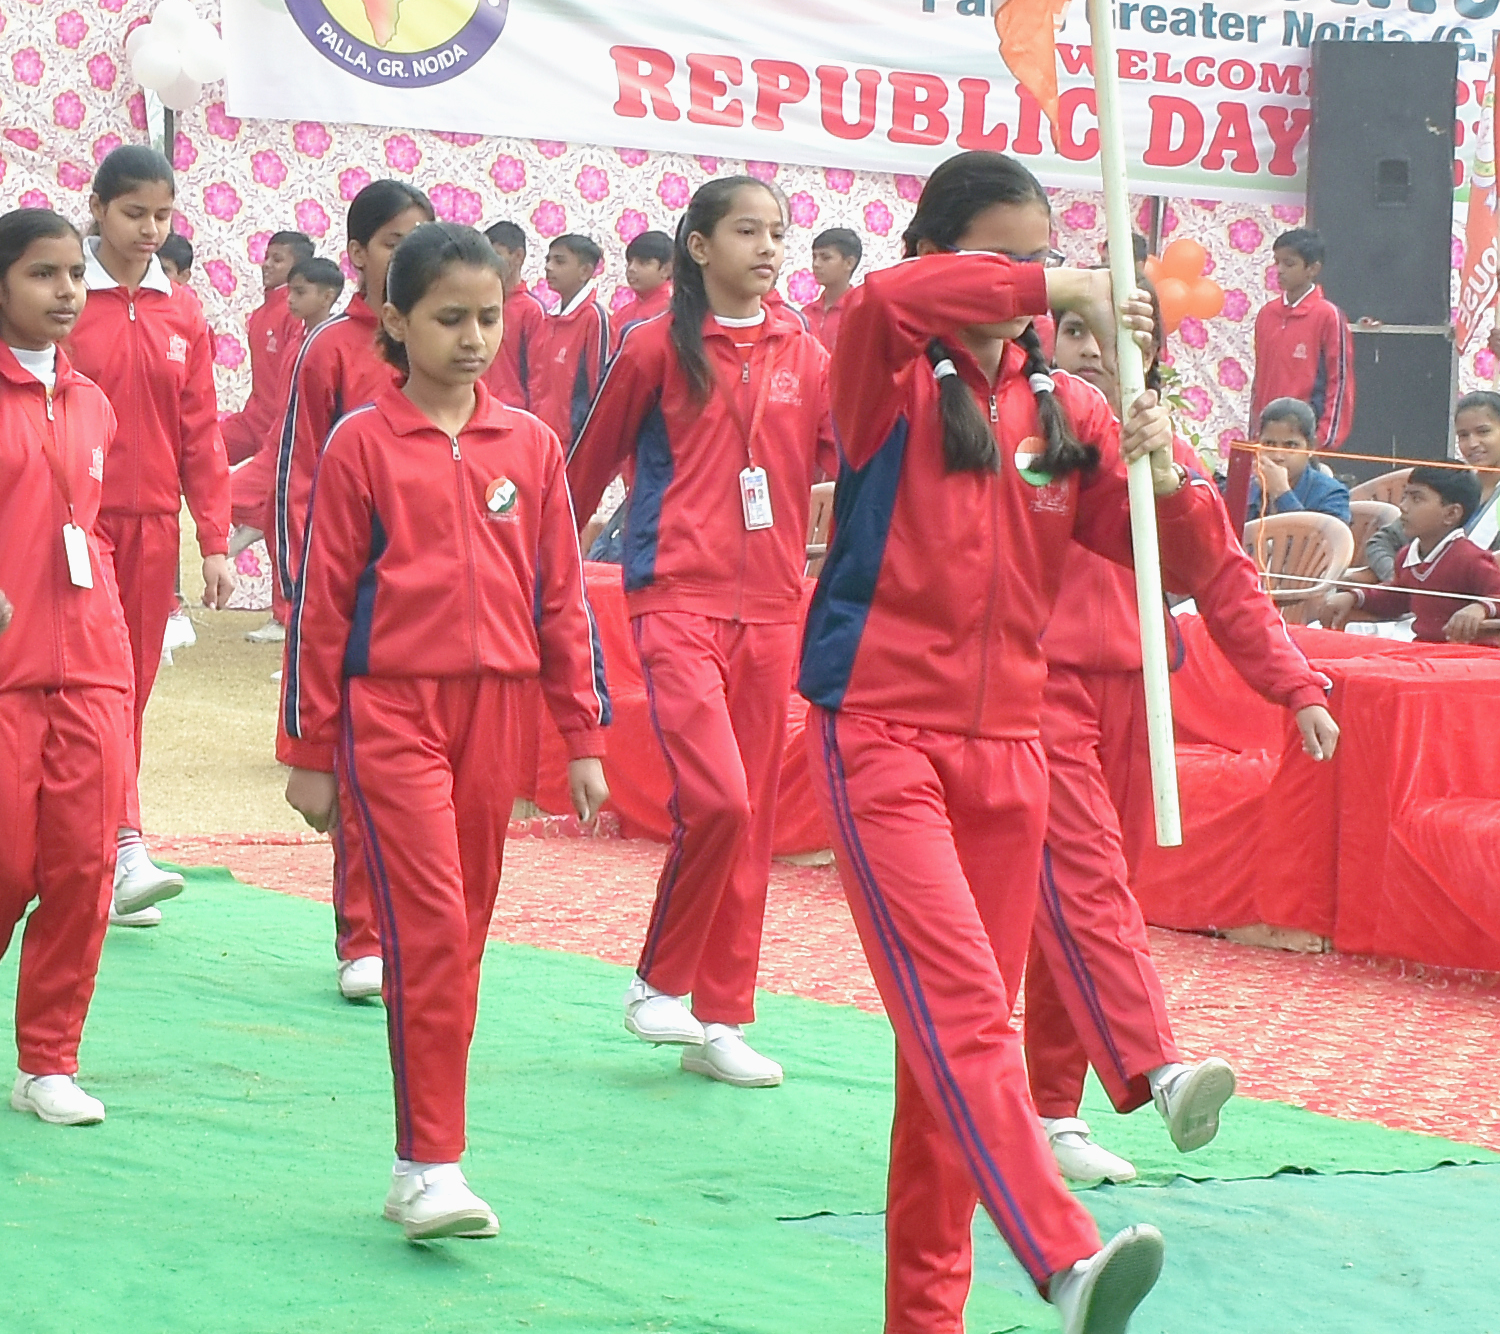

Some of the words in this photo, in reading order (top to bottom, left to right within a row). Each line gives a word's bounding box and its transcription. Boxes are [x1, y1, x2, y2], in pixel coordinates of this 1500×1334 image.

[316, 22, 372, 74] PALLA,
[376, 58, 409, 78] GR.
[412, 44, 468, 77] NOIDA
[1055, 43, 1312, 96] WELCOM
[609, 46, 1098, 160] REPUBLIC
[1143, 95, 1312, 177] DAY
